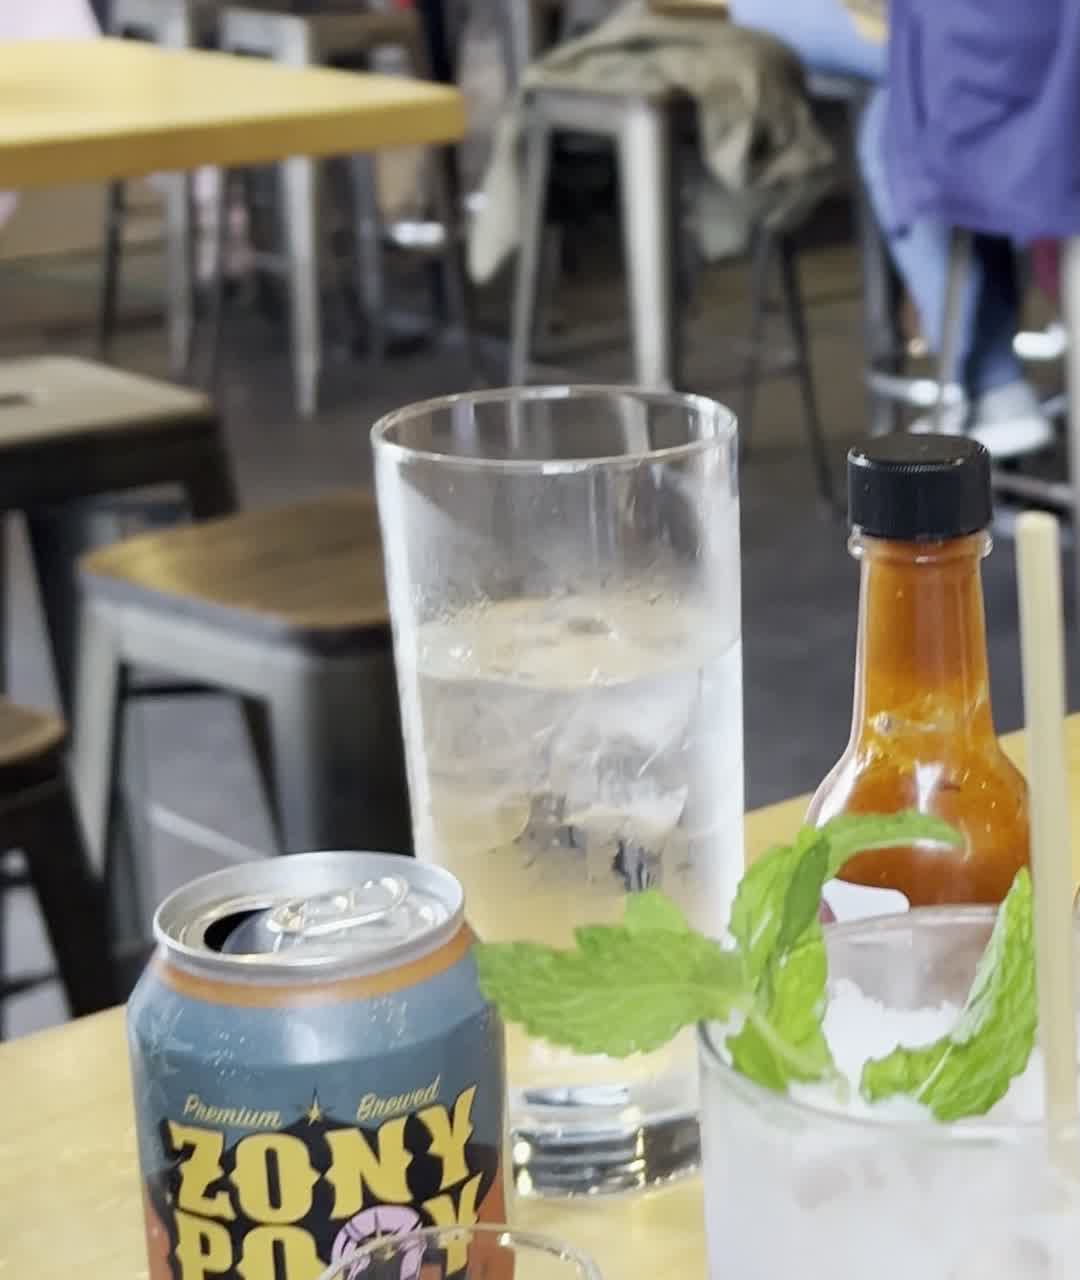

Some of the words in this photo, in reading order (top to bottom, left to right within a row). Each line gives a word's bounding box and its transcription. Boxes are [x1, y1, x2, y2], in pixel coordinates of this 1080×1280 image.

[183, 1093, 282, 1128] Premium
[357, 1074, 441, 1122] Brewed
[168, 1084, 477, 1224] ZONY
